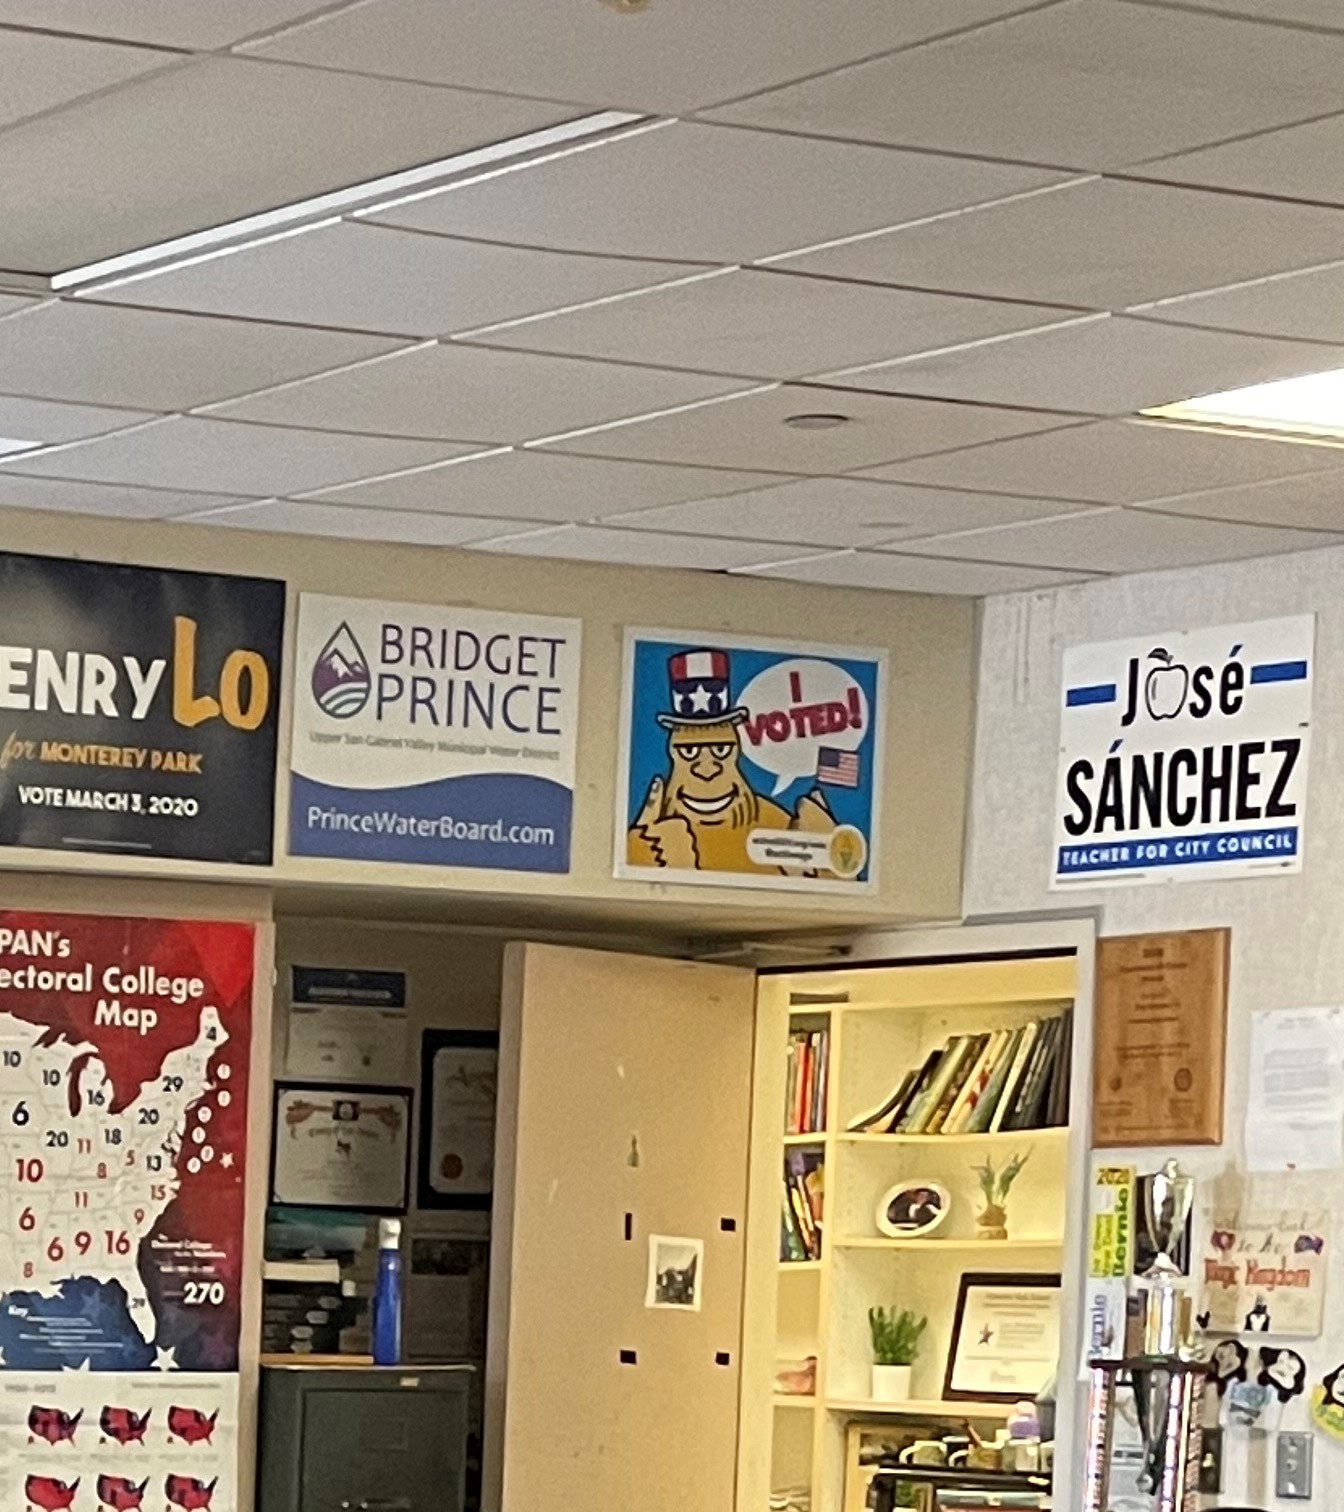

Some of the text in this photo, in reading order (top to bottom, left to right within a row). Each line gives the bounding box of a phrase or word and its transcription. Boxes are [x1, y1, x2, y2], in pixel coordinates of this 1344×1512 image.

[380, 623, 566, 679] BRIDGET
[790, 671, 802, 703] I
[375, 673, 563, 735] PRINCE
[744, 687, 862, 746] VOTED!
[0, 730, 203, 774] for MONTEREY PARK
[18, 784, 63, 807] VOTE
[65, 788, 128, 812] MARCH
[148, 795, 200, 817] 2020
[1063, 739, 1302, 837] SÁNCHEZ
[307, 806, 555, 846] PrinceWaterBoard.com
[1063, 833, 1293, 867] TEACHER FOR CITY COUNCIL
[102, 965, 205, 1005] College
[94, 1000, 159, 1036] Map
[3, 1050, 22, 1068] 10
[42, 1069, 61, 1087] 10
[162, 1075, 183, 1093] 29
[87, 1088, 105, 1107] 16
[12, 1100, 29, 1126] 6
[138, 1108, 160, 1125] 20
[46, 1130, 69, 1148] 20
[104, 1127, 122, 1146] 18
[15, 1158, 43, 1182] 10
[146, 1155, 162, 1172] 13
[19, 1206, 36, 1231] 6
[47, 1236, 64, 1262] 6
[74, 1230, 91, 1256] 9
[105, 1230, 131, 1255] 16
[183, 1281, 225, 1305] 270
